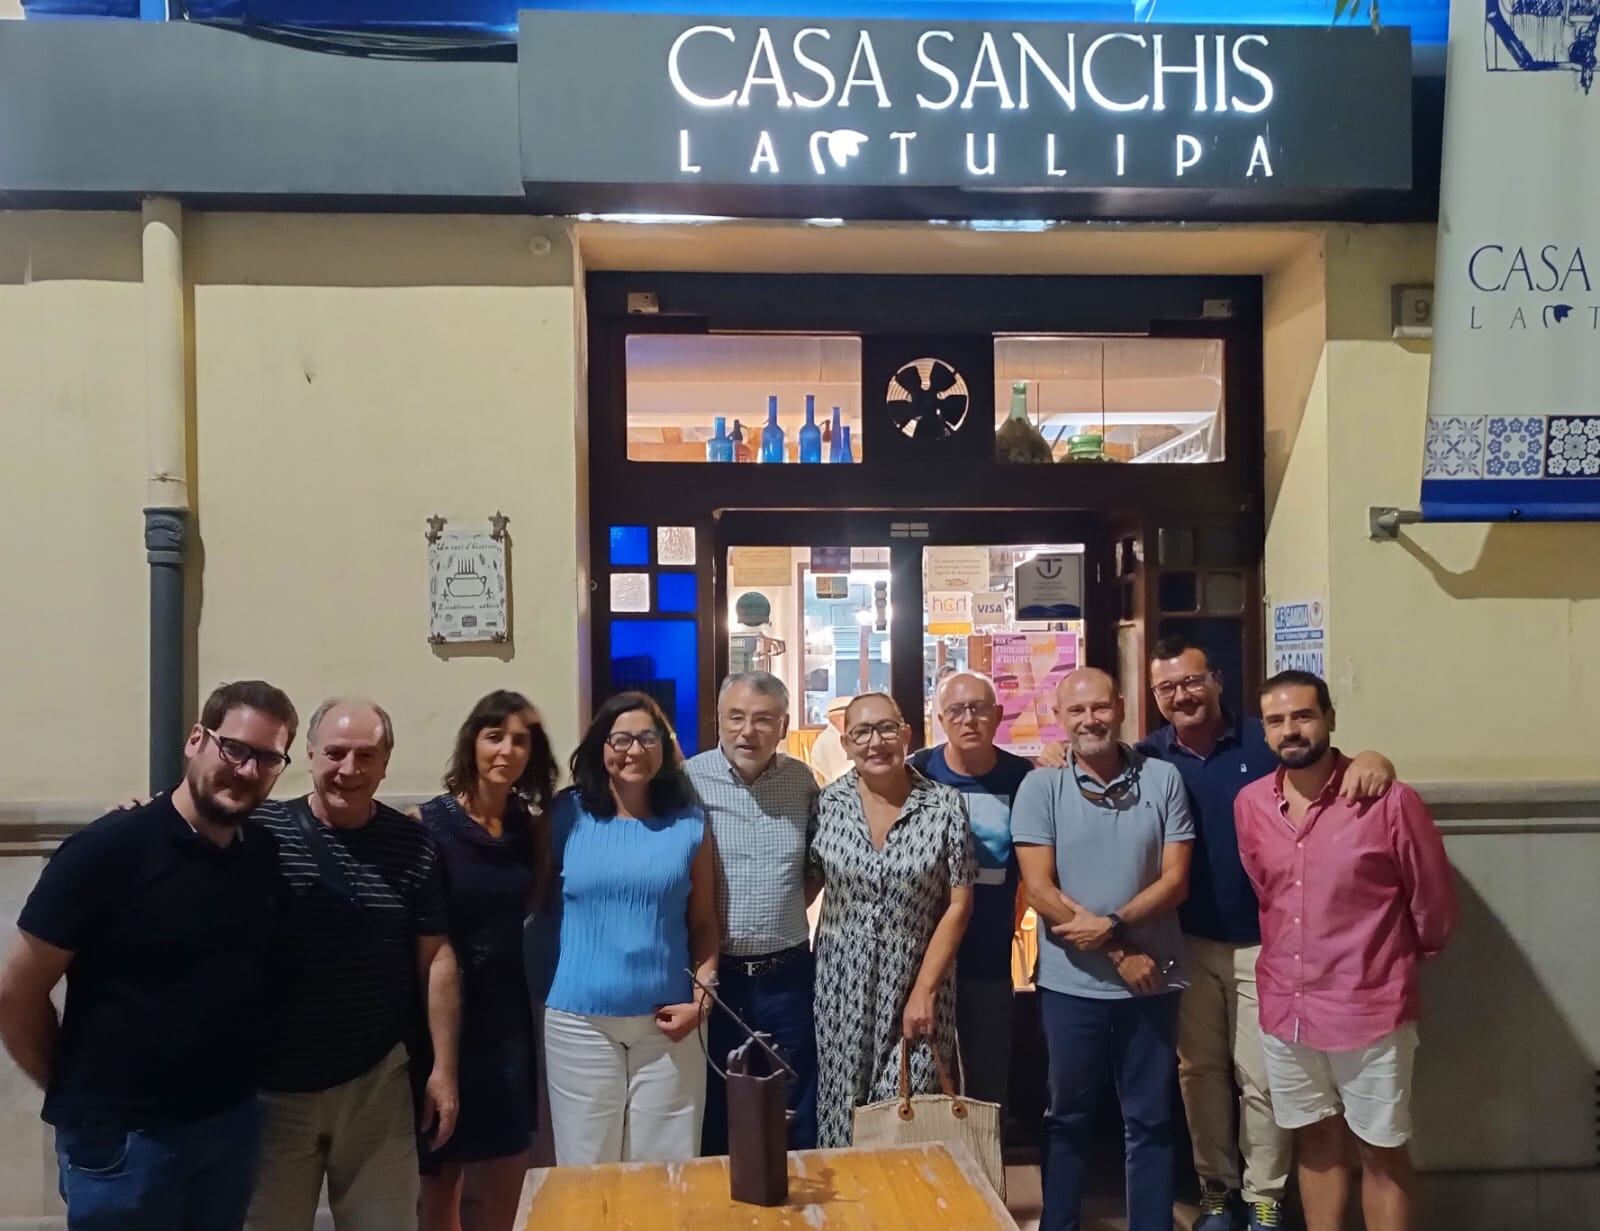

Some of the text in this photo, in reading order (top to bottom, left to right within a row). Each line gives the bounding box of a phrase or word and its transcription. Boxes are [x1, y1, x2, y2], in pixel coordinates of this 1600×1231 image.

[668, 26, 1274, 112] CASA SANCHIS
[679, 129, 1273, 176] LA TULIPA
[1468, 244, 1592, 292] CASA
[1471, 305, 1527, 329] LA
[977, 604, 1003, 613] VISA
